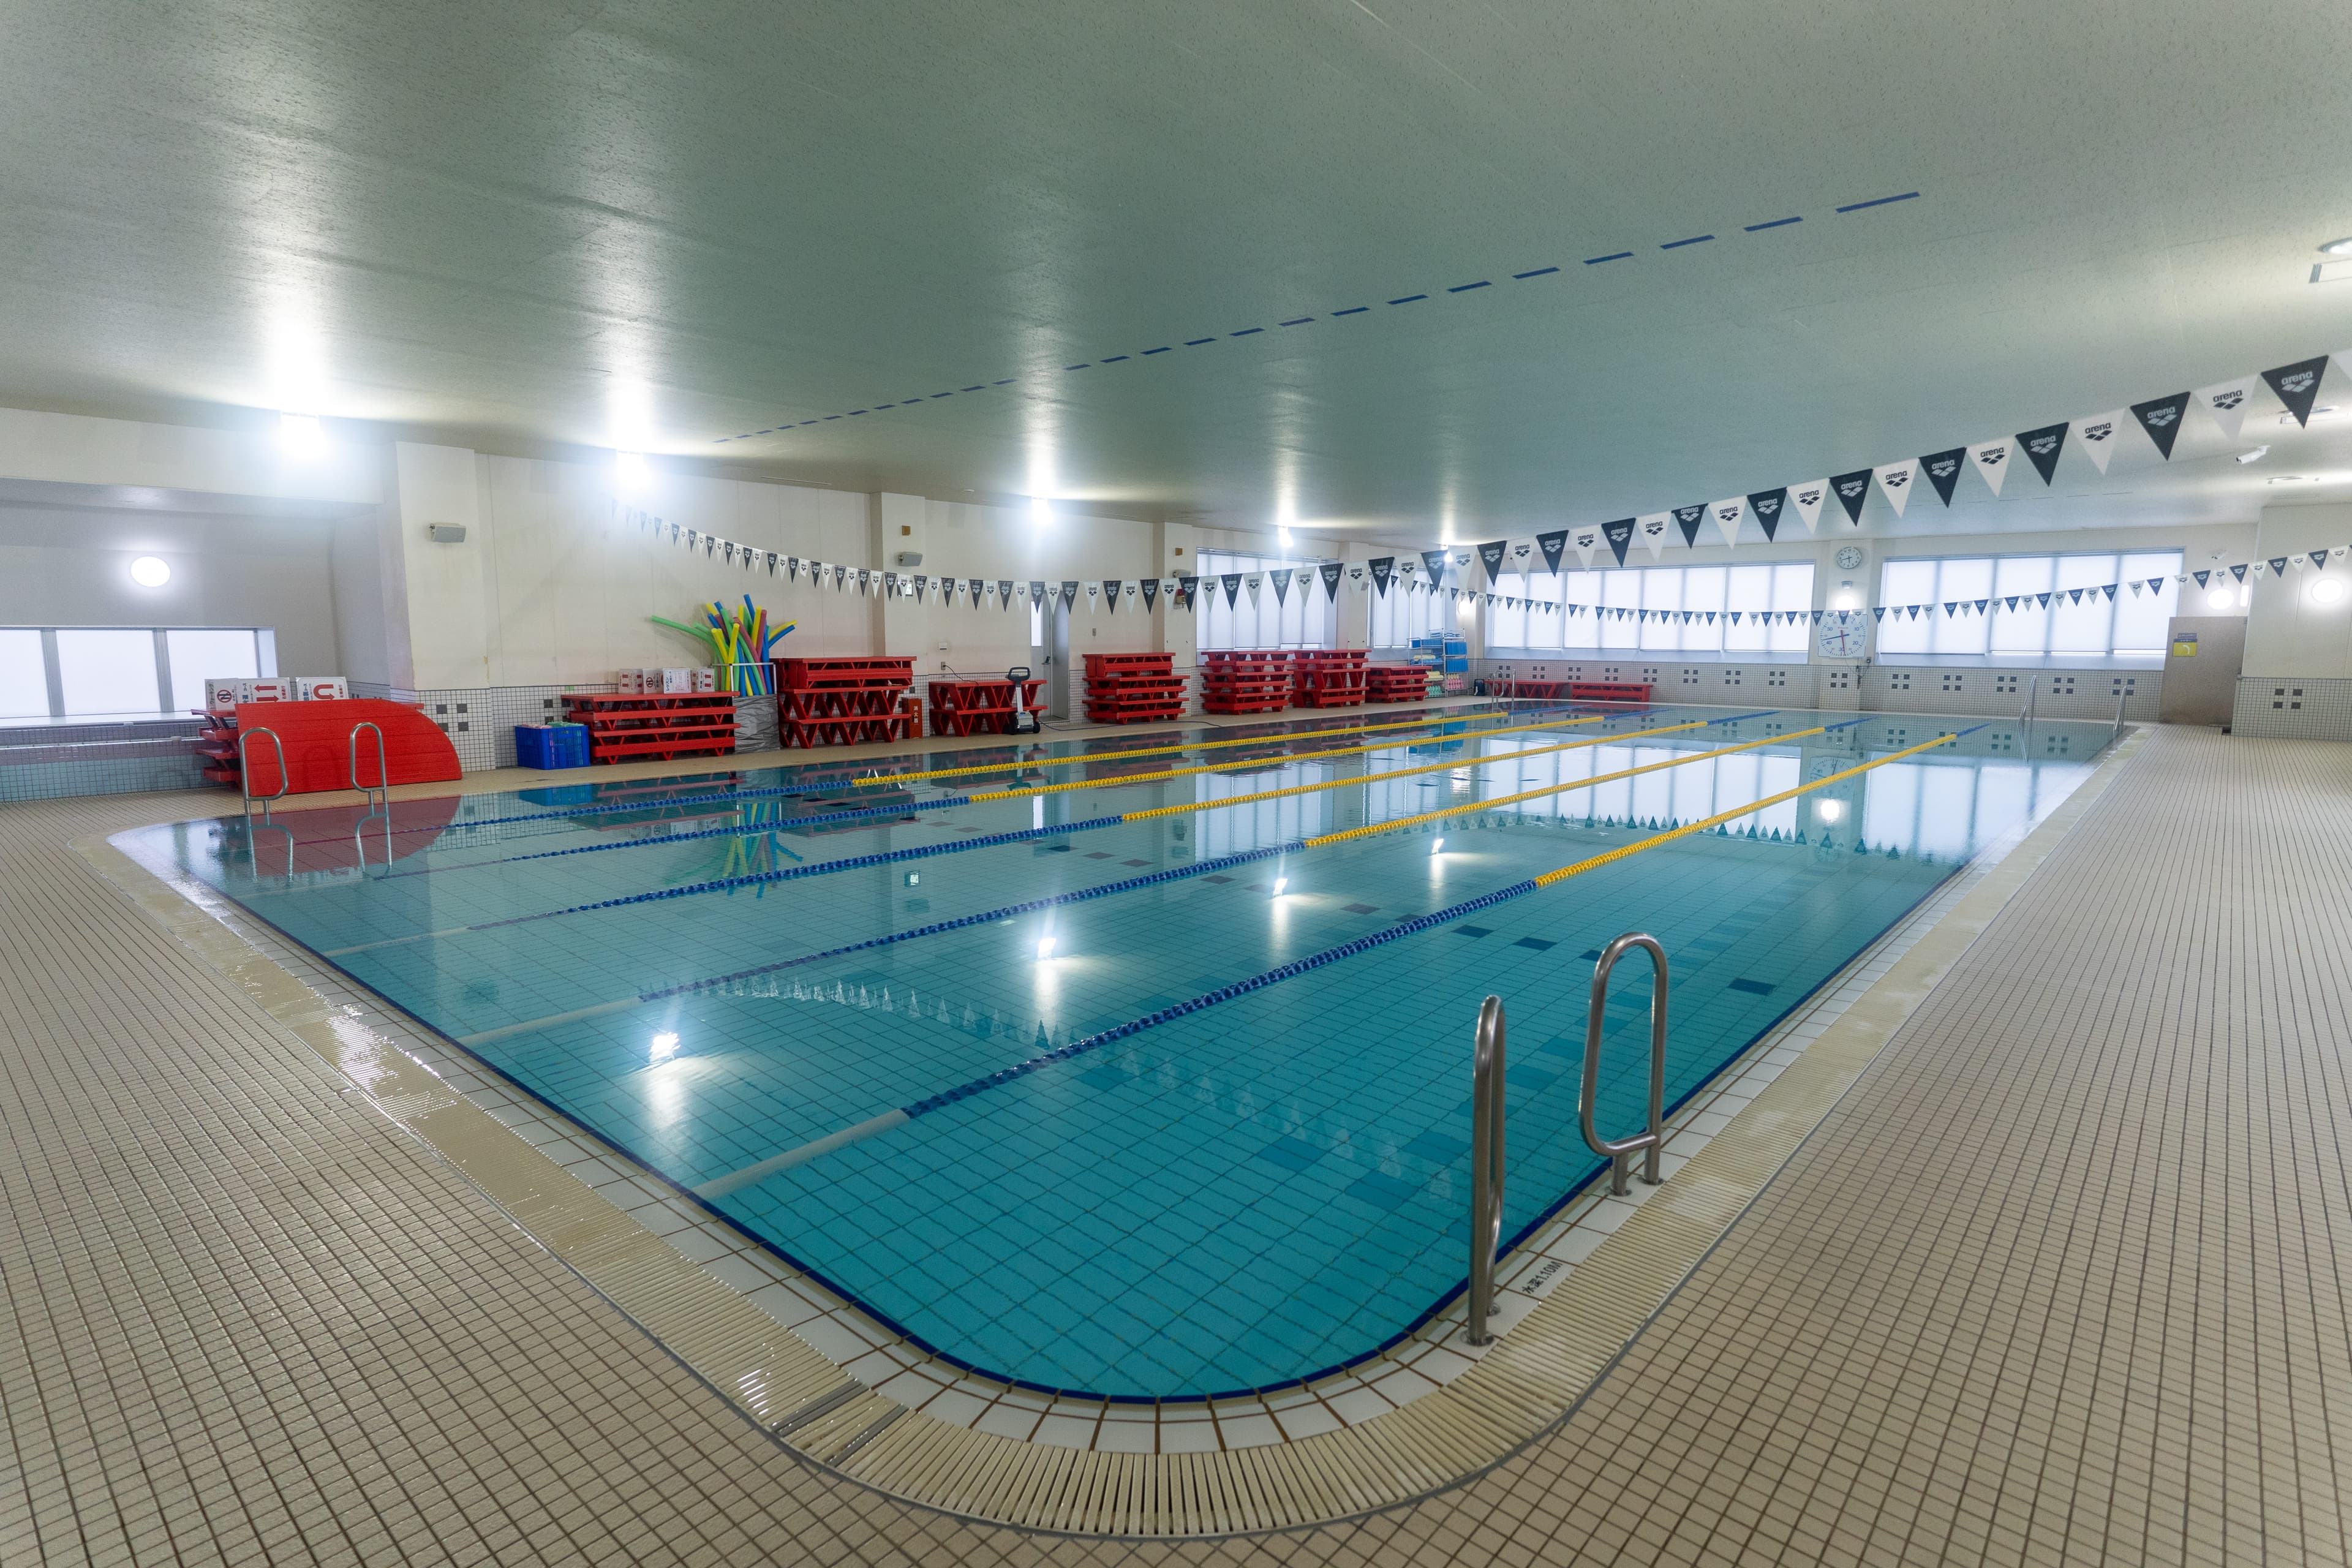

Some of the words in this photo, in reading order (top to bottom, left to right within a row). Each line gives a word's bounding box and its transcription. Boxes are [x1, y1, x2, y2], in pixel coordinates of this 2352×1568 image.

[2281, 371, 2313, 385] arena
[2213, 390, 2242, 402] arena
[2147, 405, 2176, 419] arena
[2085, 423, 2111, 434] arena
[2030, 435, 2056, 447] arena
[1980, 447, 2004, 457] arena
[1931, 459, 1955, 470] arena
[1885, 470, 1907, 480] arena
[1841, 480, 1862, 490] arena
[1799, 490, 1819, 499] arena
[1758, 499, 1777, 507] arena
[1719, 506, 1738, 514] arena
